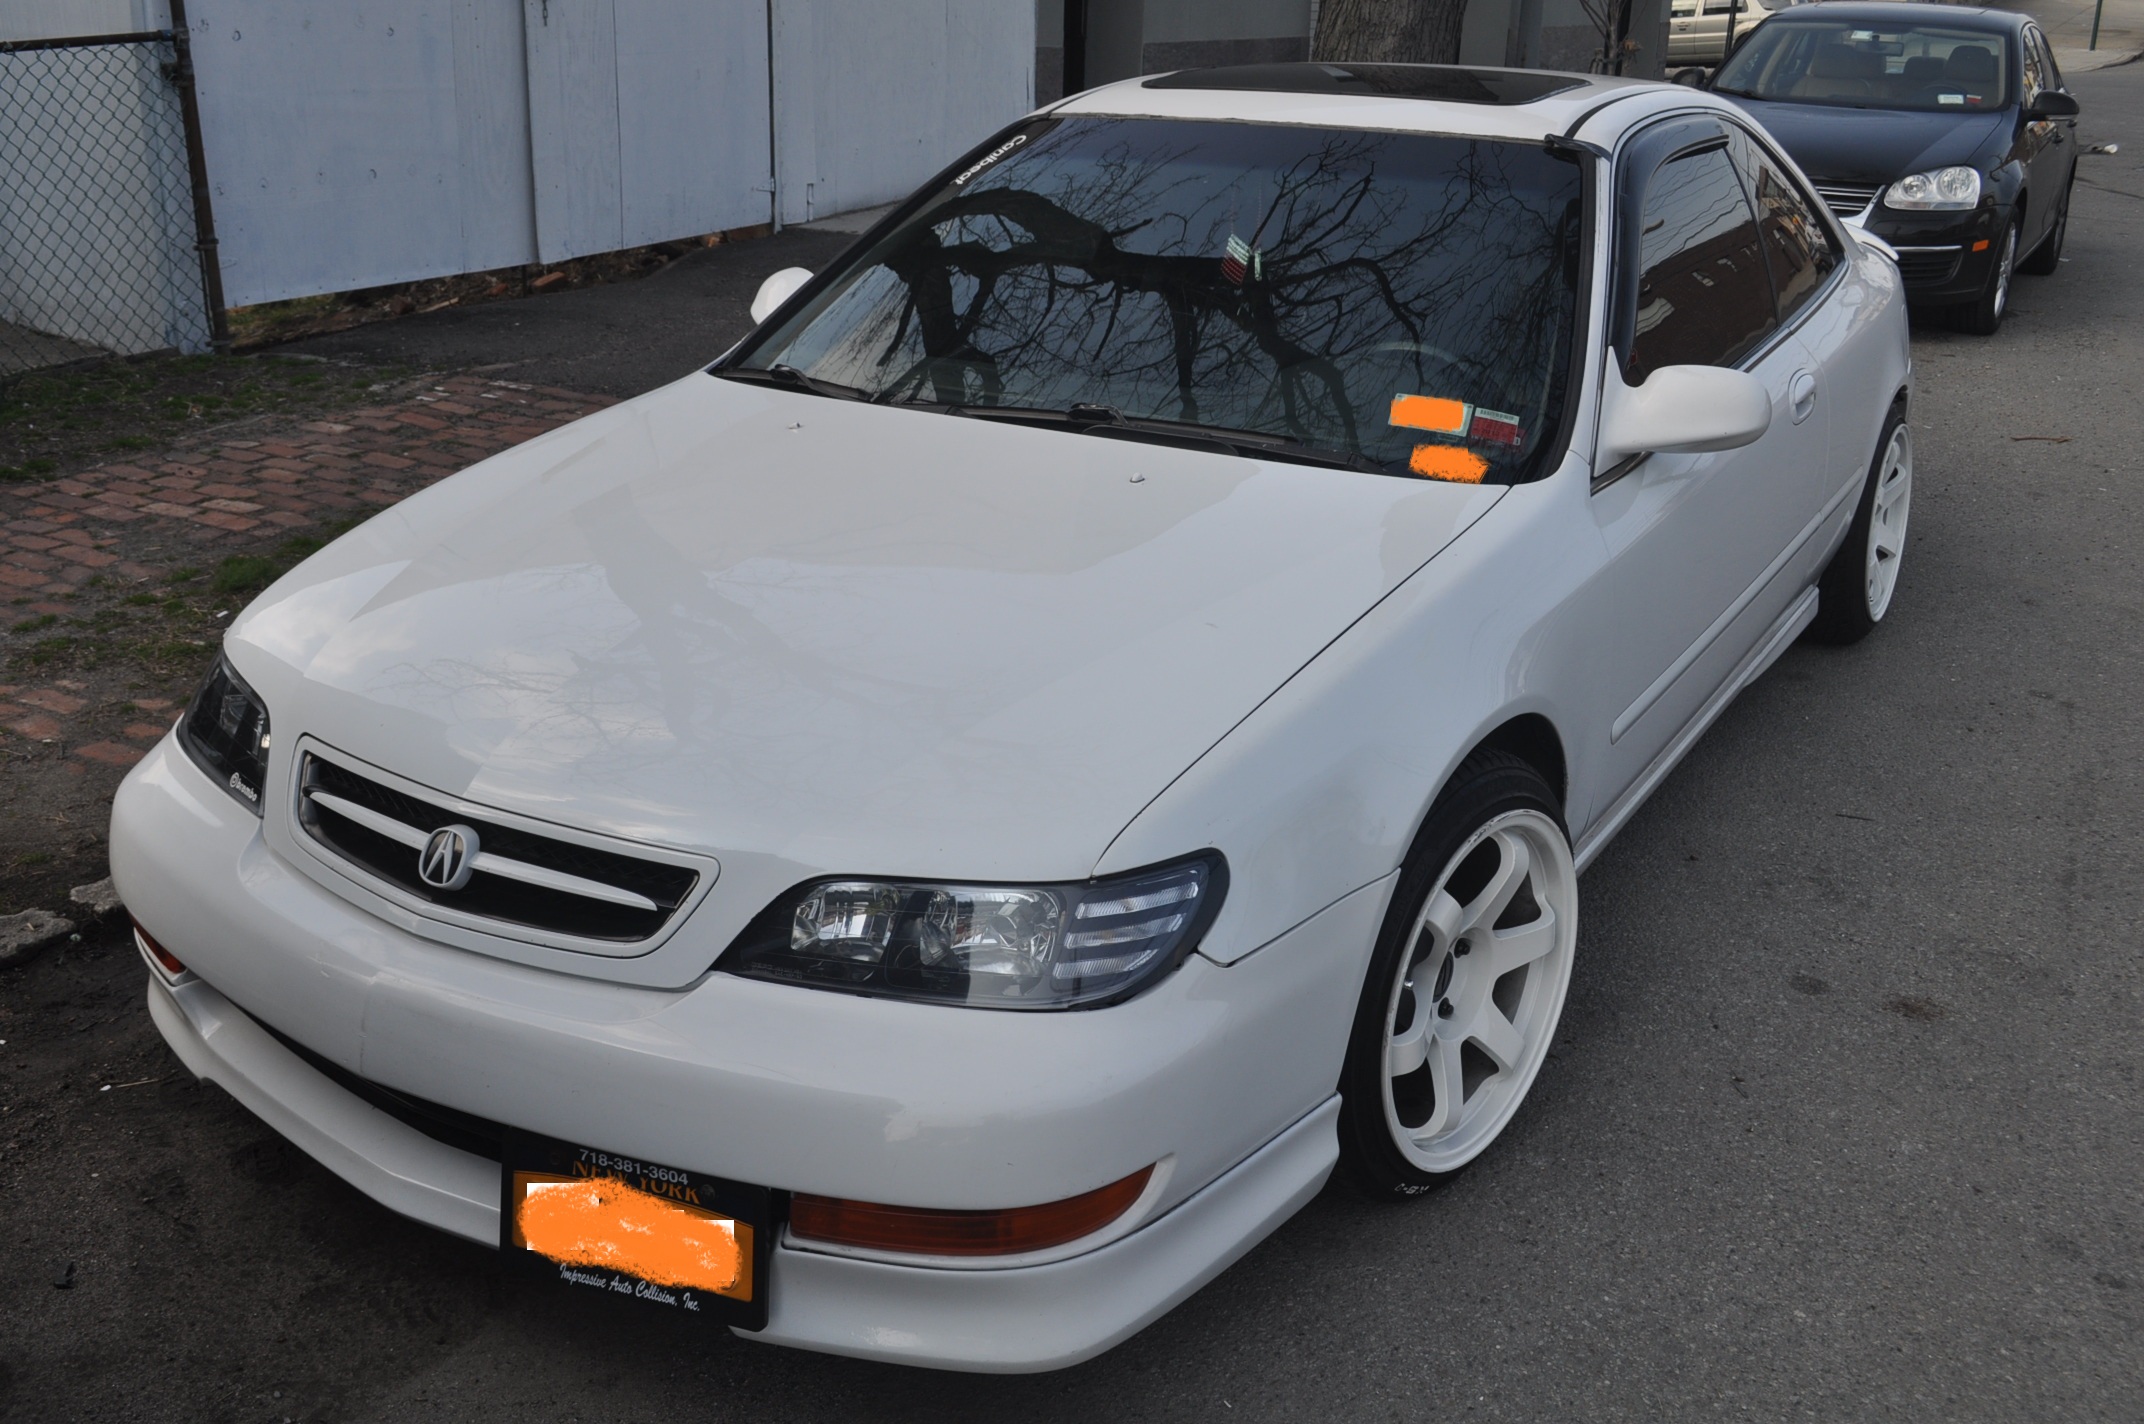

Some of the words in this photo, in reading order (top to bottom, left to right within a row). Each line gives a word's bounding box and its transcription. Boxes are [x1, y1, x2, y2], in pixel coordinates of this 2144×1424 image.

[955, 134, 1027, 185] Canibeat
[579, 1148, 688, 1185] 718-381-3604
[559, 1263, 607, 1288] Impressive
[608, 1275, 633, 1295] Auto
[635, 1280, 678, 1306] Collision,
[683, 1292, 700, 1311] Inc.
